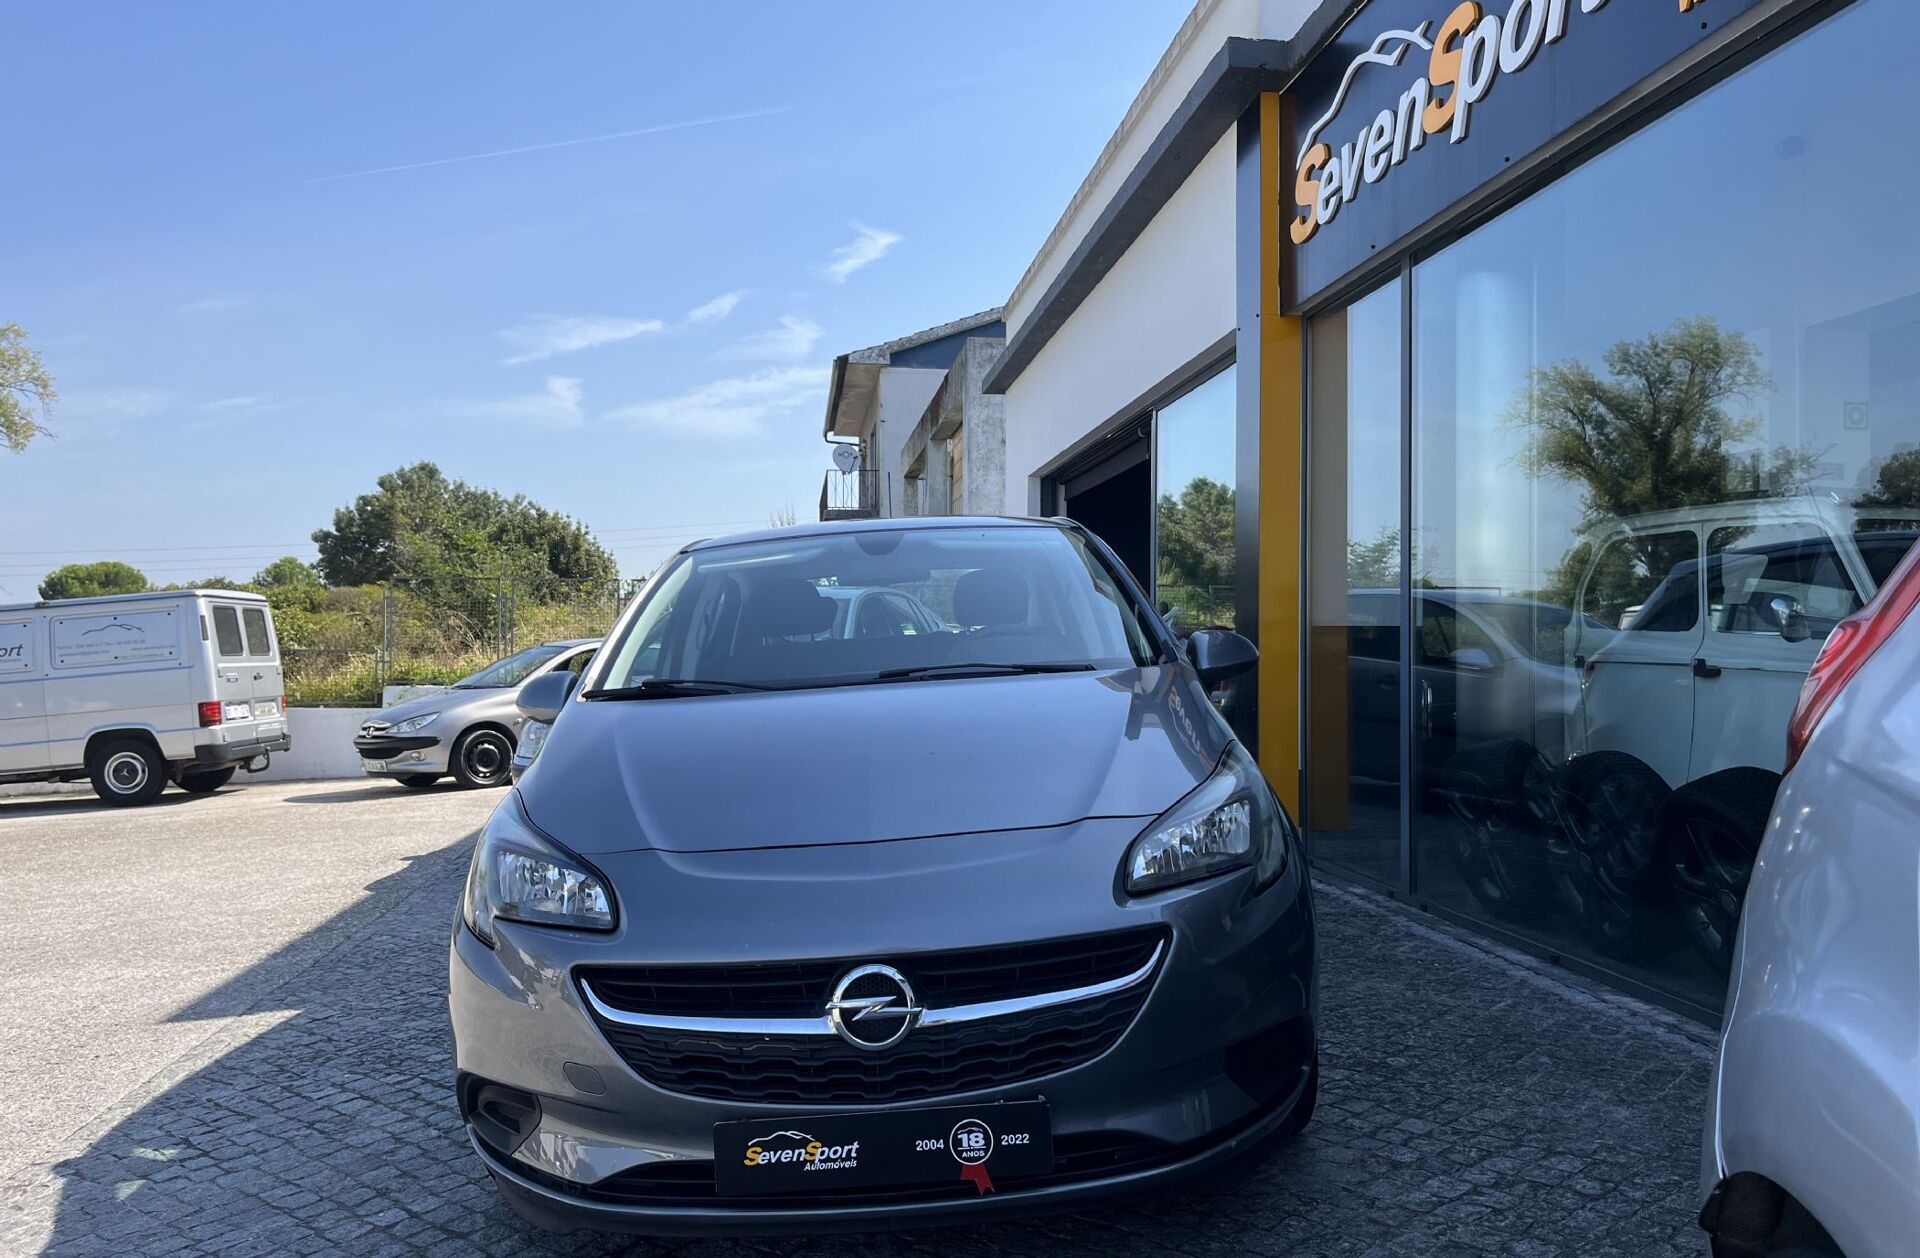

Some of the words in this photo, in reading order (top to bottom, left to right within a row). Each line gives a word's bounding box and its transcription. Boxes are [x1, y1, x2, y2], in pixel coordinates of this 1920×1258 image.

[1290, 0, 1610, 244] SevenSpo
[915, 1138, 945, 1151] 2004
[957, 1132, 985, 1148] 18
[1000, 1133, 1030, 1146] 2022
[743, 1140, 860, 1166] SevenSport
[961, 1150, 985, 1158] ANOS
[803, 1158, 858, 1172] Automóveis
